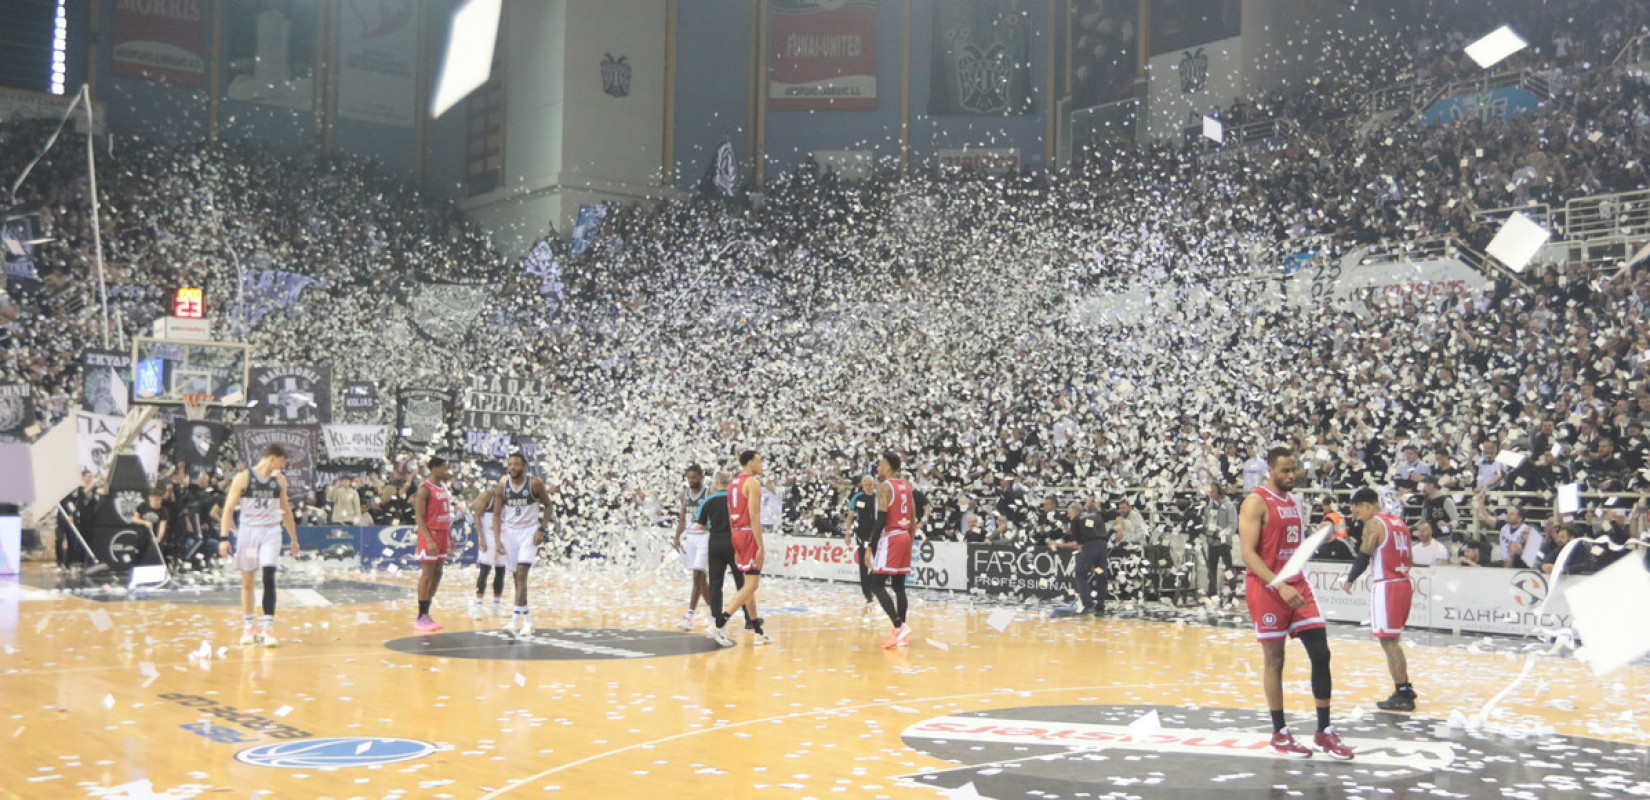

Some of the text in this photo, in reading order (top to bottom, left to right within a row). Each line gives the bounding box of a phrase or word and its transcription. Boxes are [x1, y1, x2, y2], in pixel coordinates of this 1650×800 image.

[786, 33, 861, 57] FUNAI-UNITED
[175, 297, 203, 318] 23
[86, 353, 132, 367] ΣΚΥΔΡ
[76, 414, 157, 444] ΠΑΚ
[252, 490, 274, 498] PAOK
[508, 498, 528, 506] PAOK
[254, 498, 269, 509] 34
[900, 494, 908, 514] 2
[1276, 505, 1300, 519] CHOLE
[1286, 525, 1300, 543] 25
[974, 549, 1076, 579] FARCOM
[974, 576, 1075, 591] PROFESSIONAL
